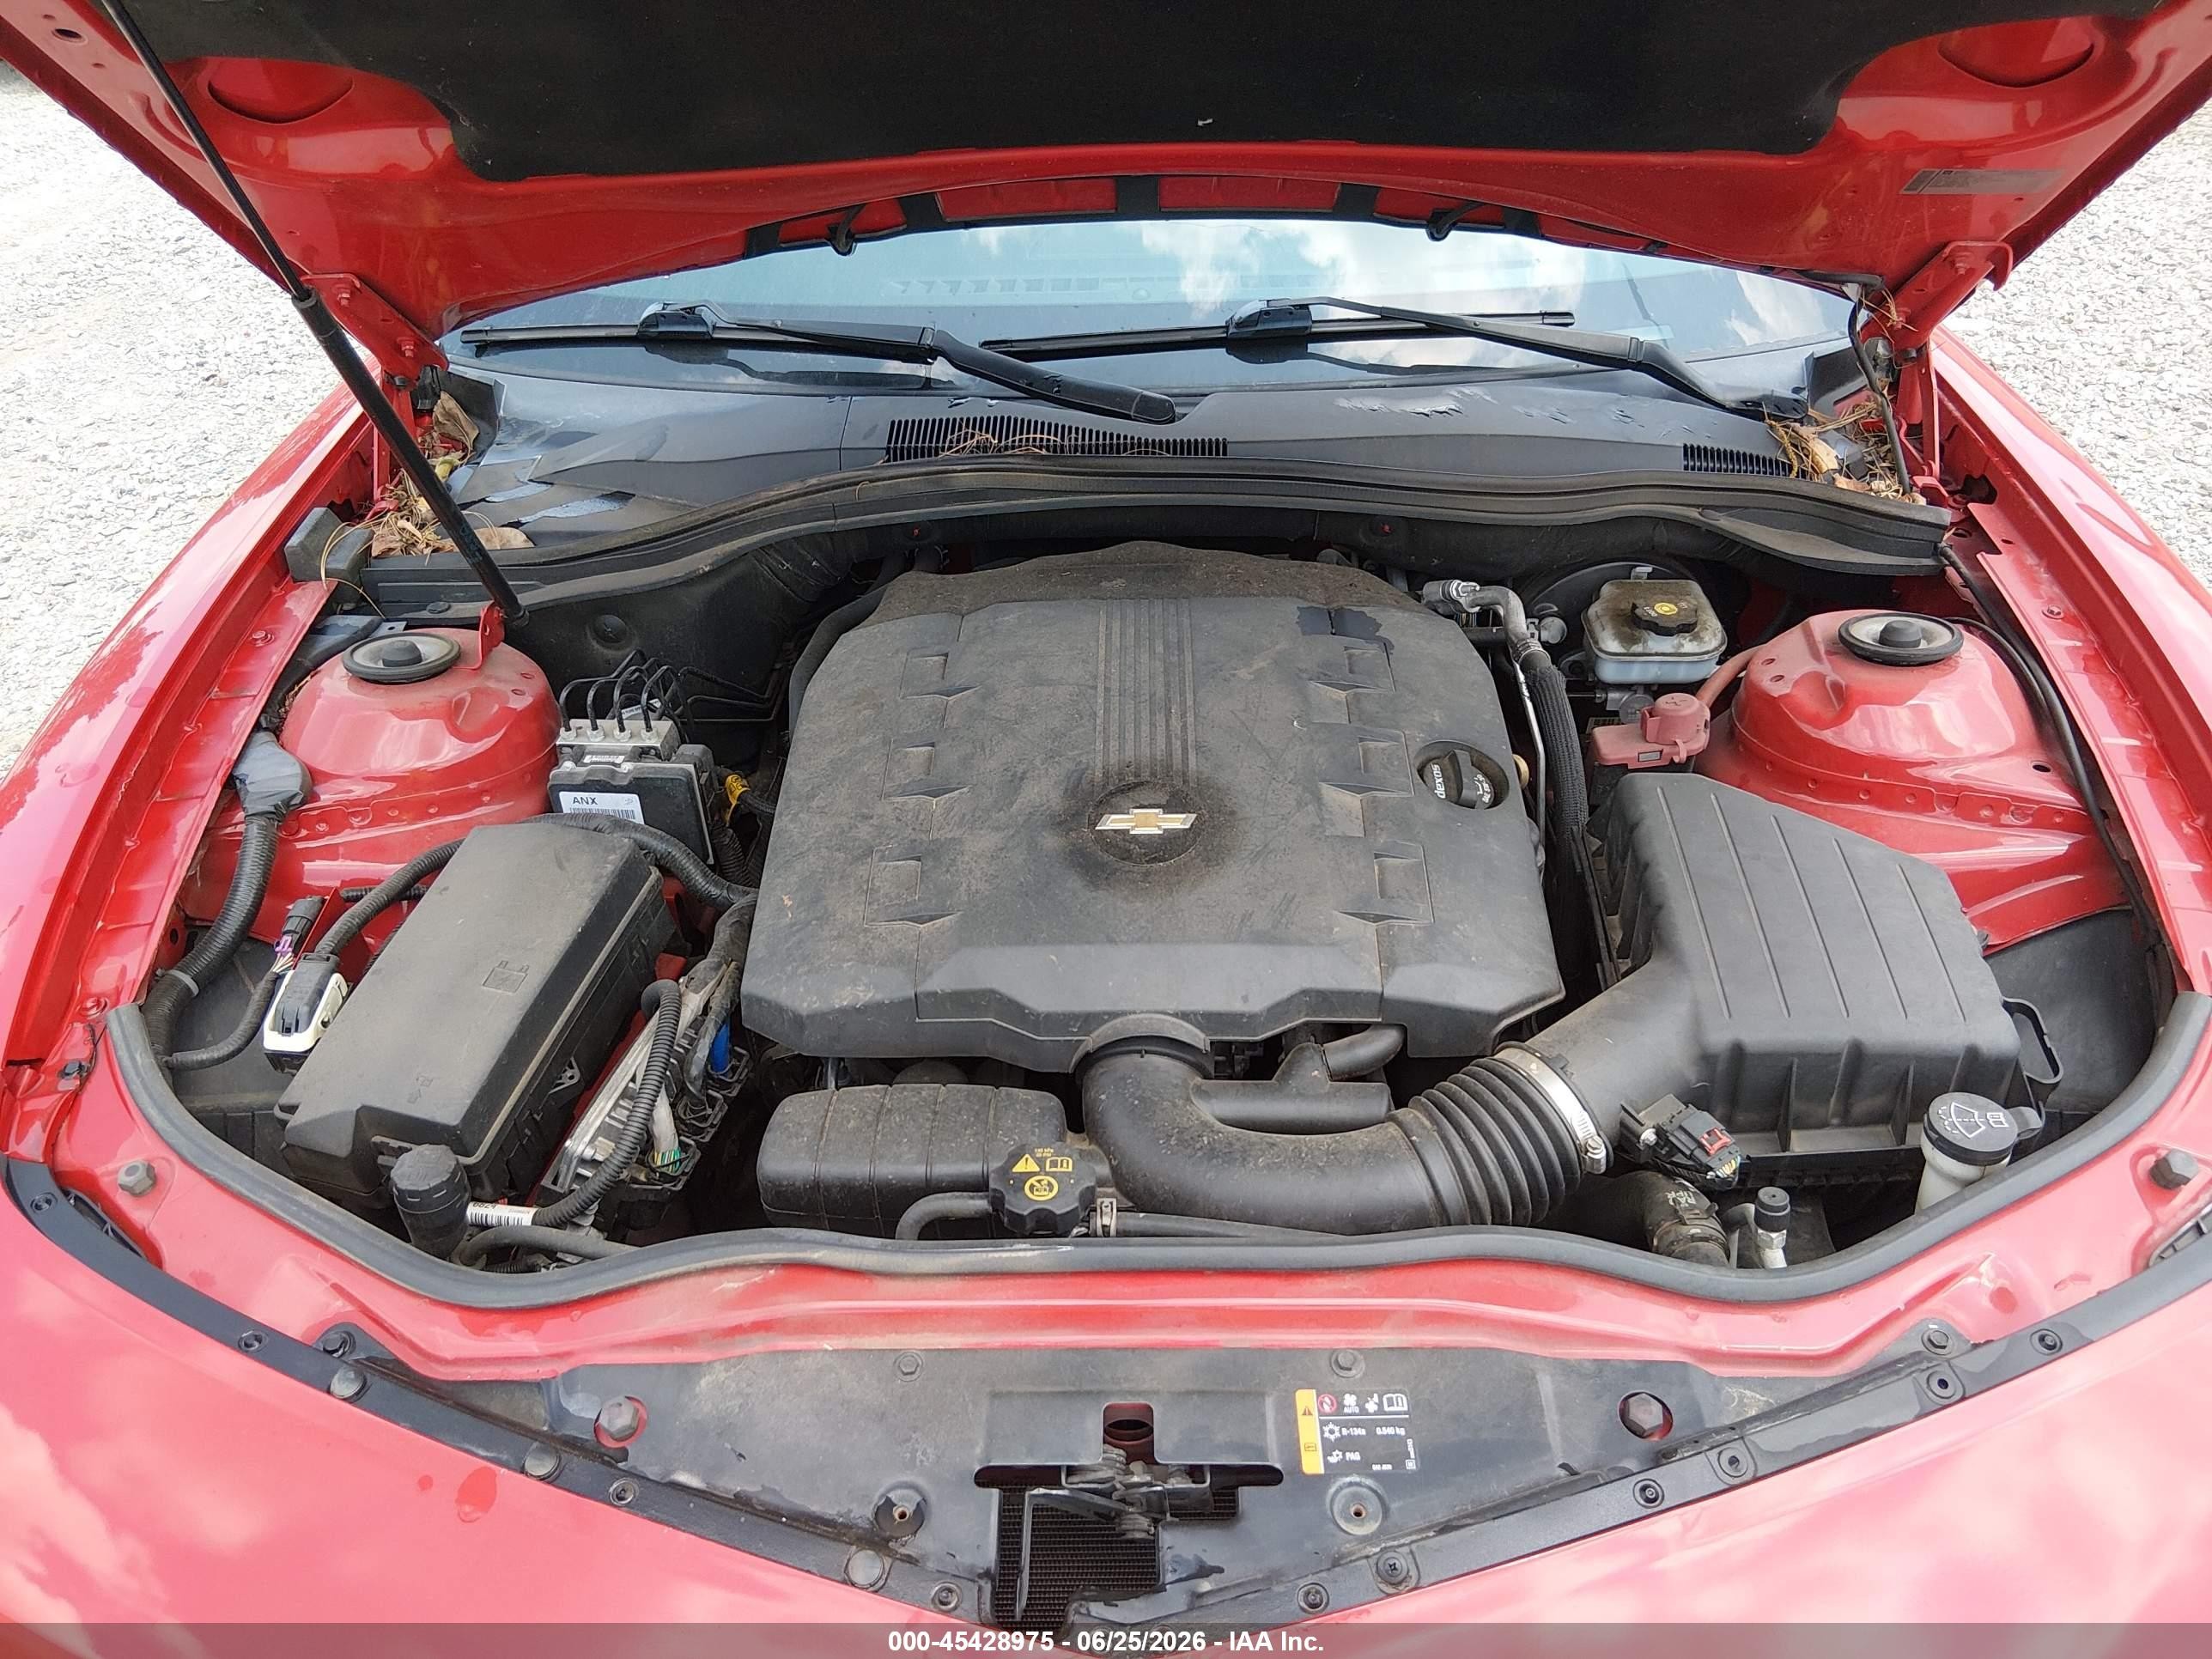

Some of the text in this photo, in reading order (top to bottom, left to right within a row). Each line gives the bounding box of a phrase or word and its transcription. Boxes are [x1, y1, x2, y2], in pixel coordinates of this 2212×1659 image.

[1431, 763, 1446, 799] dexos
[573, 796, 599, 805] ANX
[1345, 1451, 1361, 1462] PAG
